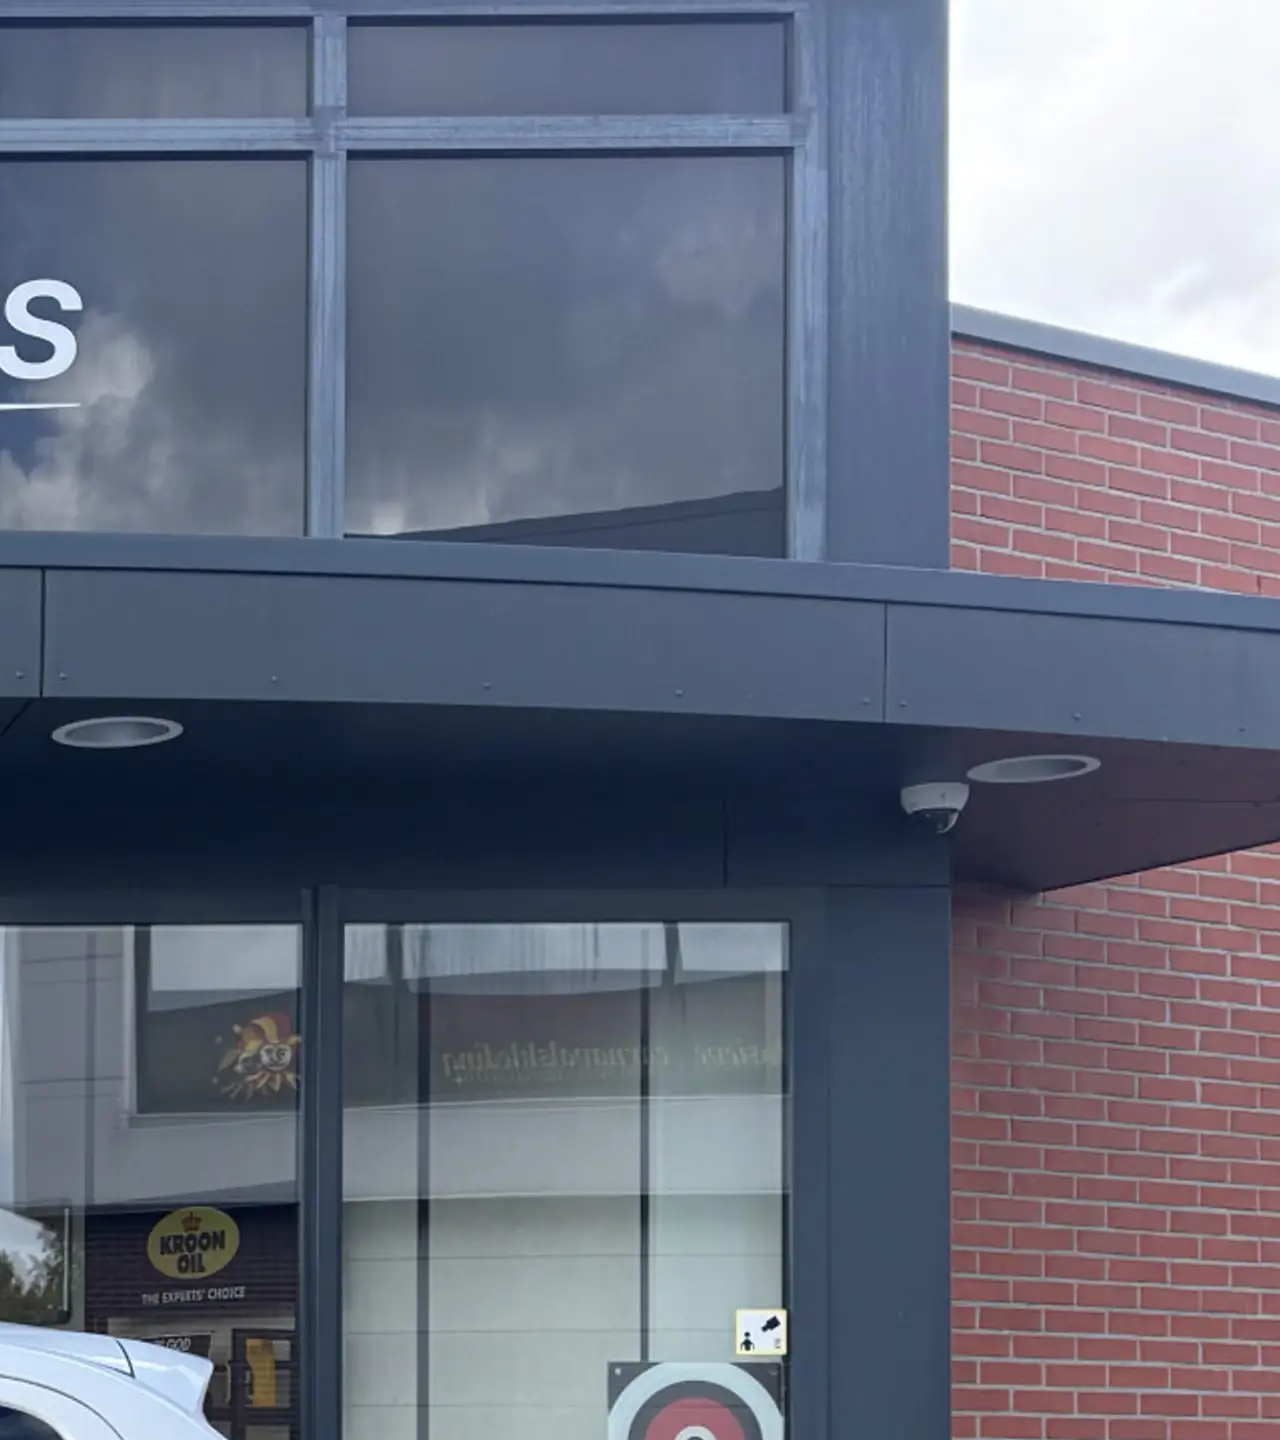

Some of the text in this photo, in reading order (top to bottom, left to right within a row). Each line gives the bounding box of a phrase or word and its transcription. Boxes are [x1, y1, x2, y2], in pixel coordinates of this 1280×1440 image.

[159, 1230, 226, 1255] KROON
[176, 1253, 206, 1274] OIL
[142, 1294, 160, 1305] THE
[207, 1286, 246, 1300] CHOICE
